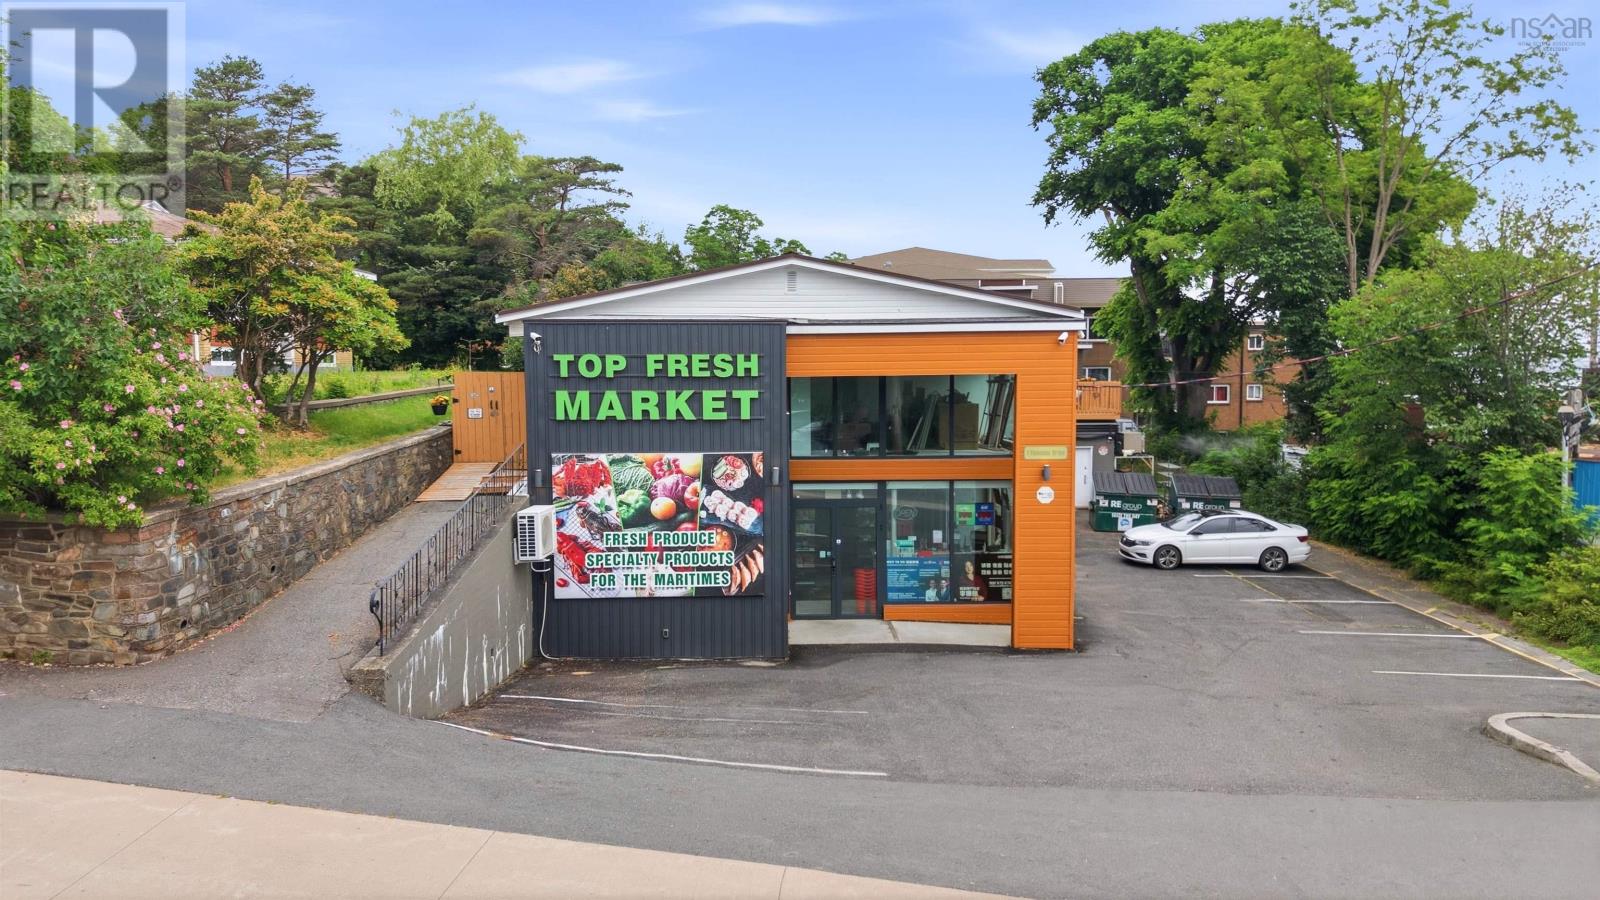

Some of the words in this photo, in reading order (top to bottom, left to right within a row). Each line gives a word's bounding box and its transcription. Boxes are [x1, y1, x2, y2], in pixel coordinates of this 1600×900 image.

[553, 353, 627, 378] TOP
[646, 353, 760, 378] FRESH
[554, 390, 759, 421] MARKET
[1110, 500, 1122, 508] RE
[1122, 503, 1142, 511] group
[604, 532, 647, 546] FRESH
[653, 531, 715, 546] PRODUCE
[587, 553, 658, 566] SPECIALTY
[664, 552, 734, 566] PRODUCTS
[590, 573, 616, 587] FOR
[624, 573, 647, 586] THE
[654, 572, 730, 586] MARITIMES
